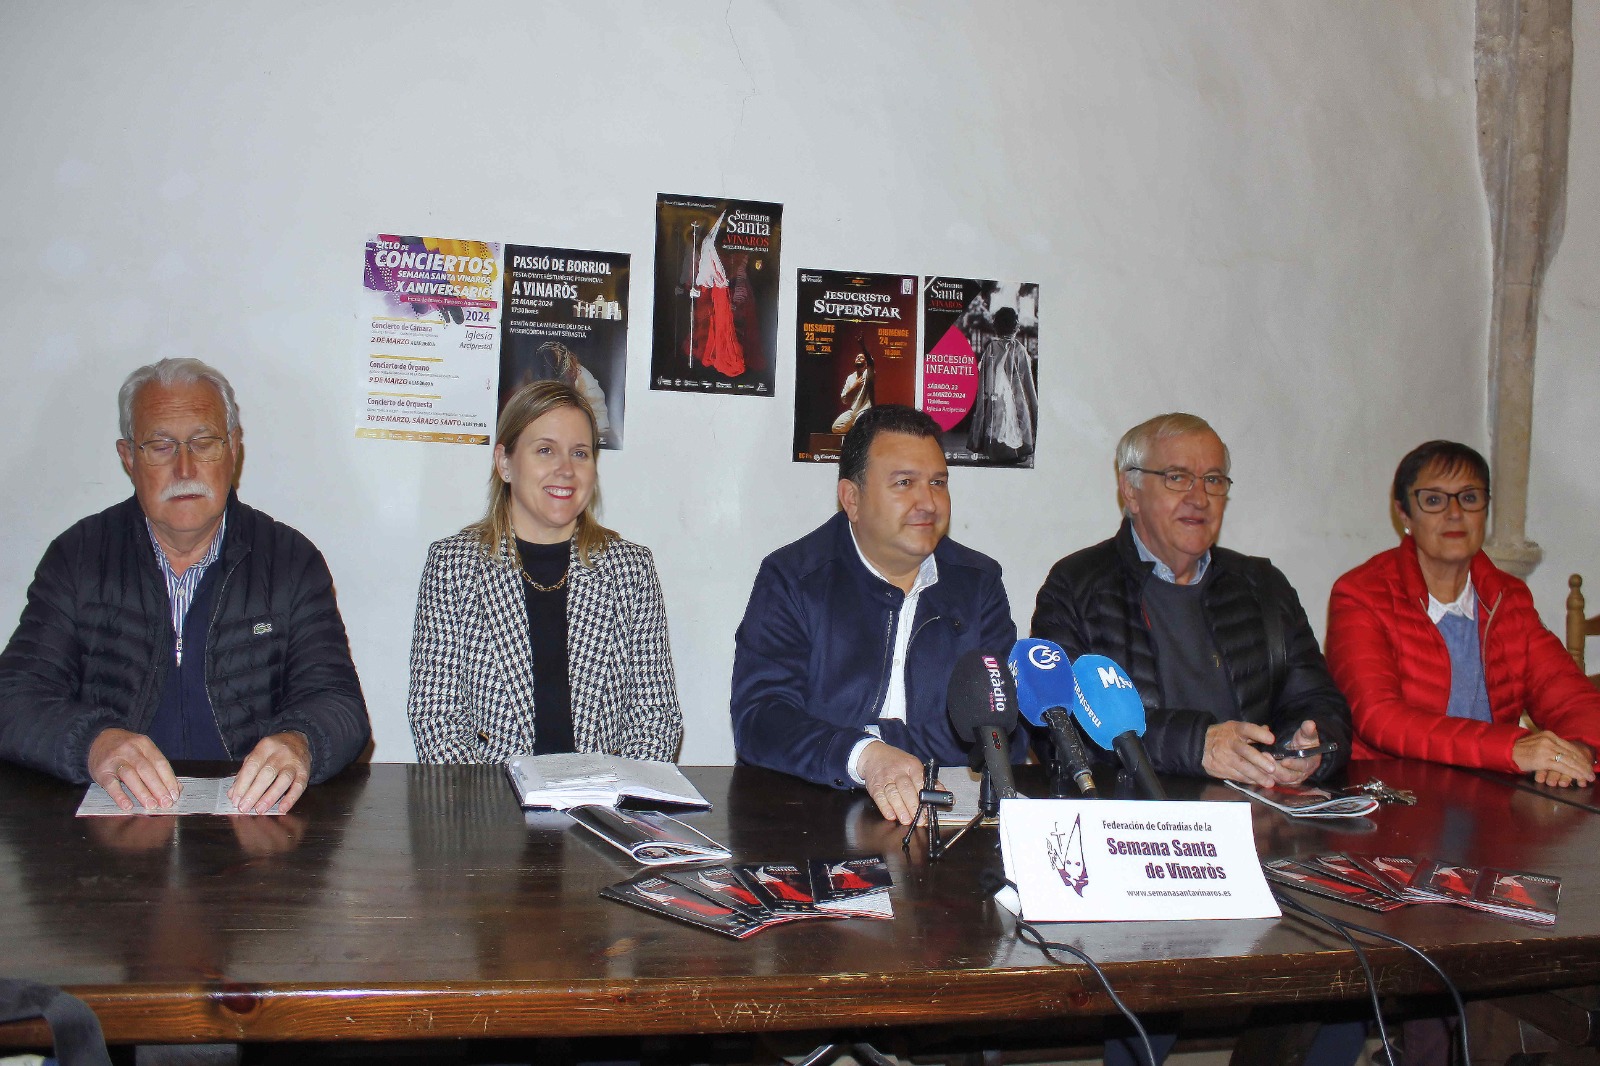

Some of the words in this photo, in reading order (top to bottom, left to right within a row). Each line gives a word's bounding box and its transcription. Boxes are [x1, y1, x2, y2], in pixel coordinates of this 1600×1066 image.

[727, 215, 770, 236] Santa
[376, 241, 400, 250] CICLO
[375, 250, 495, 274] CONCIERTOS
[513, 256, 549, 270] PASSIÓ
[552, 258, 565, 271] DE
[566, 260, 612, 275] BORRIOL
[397, 270, 430, 280] SEMANA
[430, 272, 456, 281] SANTA
[396, 281, 404, 292] X
[404, 282, 491, 299] ANIVERSARIO
[512, 281, 521, 295] A
[523, 281, 578, 299] VINARÒS
[930, 285, 963, 300] Santa
[823, 290, 892, 303] JESUCRISTO
[466, 311, 490, 322] 2024
[371, 322, 400, 331] Concierto
[803, 323, 836, 333] DISSABTE
[465, 330, 493, 341] Iglesia
[805, 332, 815, 341] 23
[878, 328, 909, 337] DIUMENGE
[385, 337, 410, 345] MARZO
[879, 337, 889, 345] 24
[926, 354, 974, 365] PROCESIÓN
[369, 361, 398, 370] Concierto
[407, 361, 430, 372] Órgano
[926, 364, 975, 376] INFANTIL
[384, 377, 408, 385] MARZO
[367, 397, 396, 406] Concierto
[397, 399, 405, 407] de
[405, 400, 433, 409] Orquesta
[1102, 819, 1145, 832] Federación
[1146, 821, 1156, 831] de
[1193, 822, 1204, 832] de
[1205, 822, 1212, 832] la
[1106, 837, 1170, 856] Semana
[1171, 838, 1218, 858] Santa
[1145, 861, 1165, 879] de
[1165, 861, 1227, 880] Vinaròs
[1126, 889, 1232, 898] www.semanasantavinaros.es
